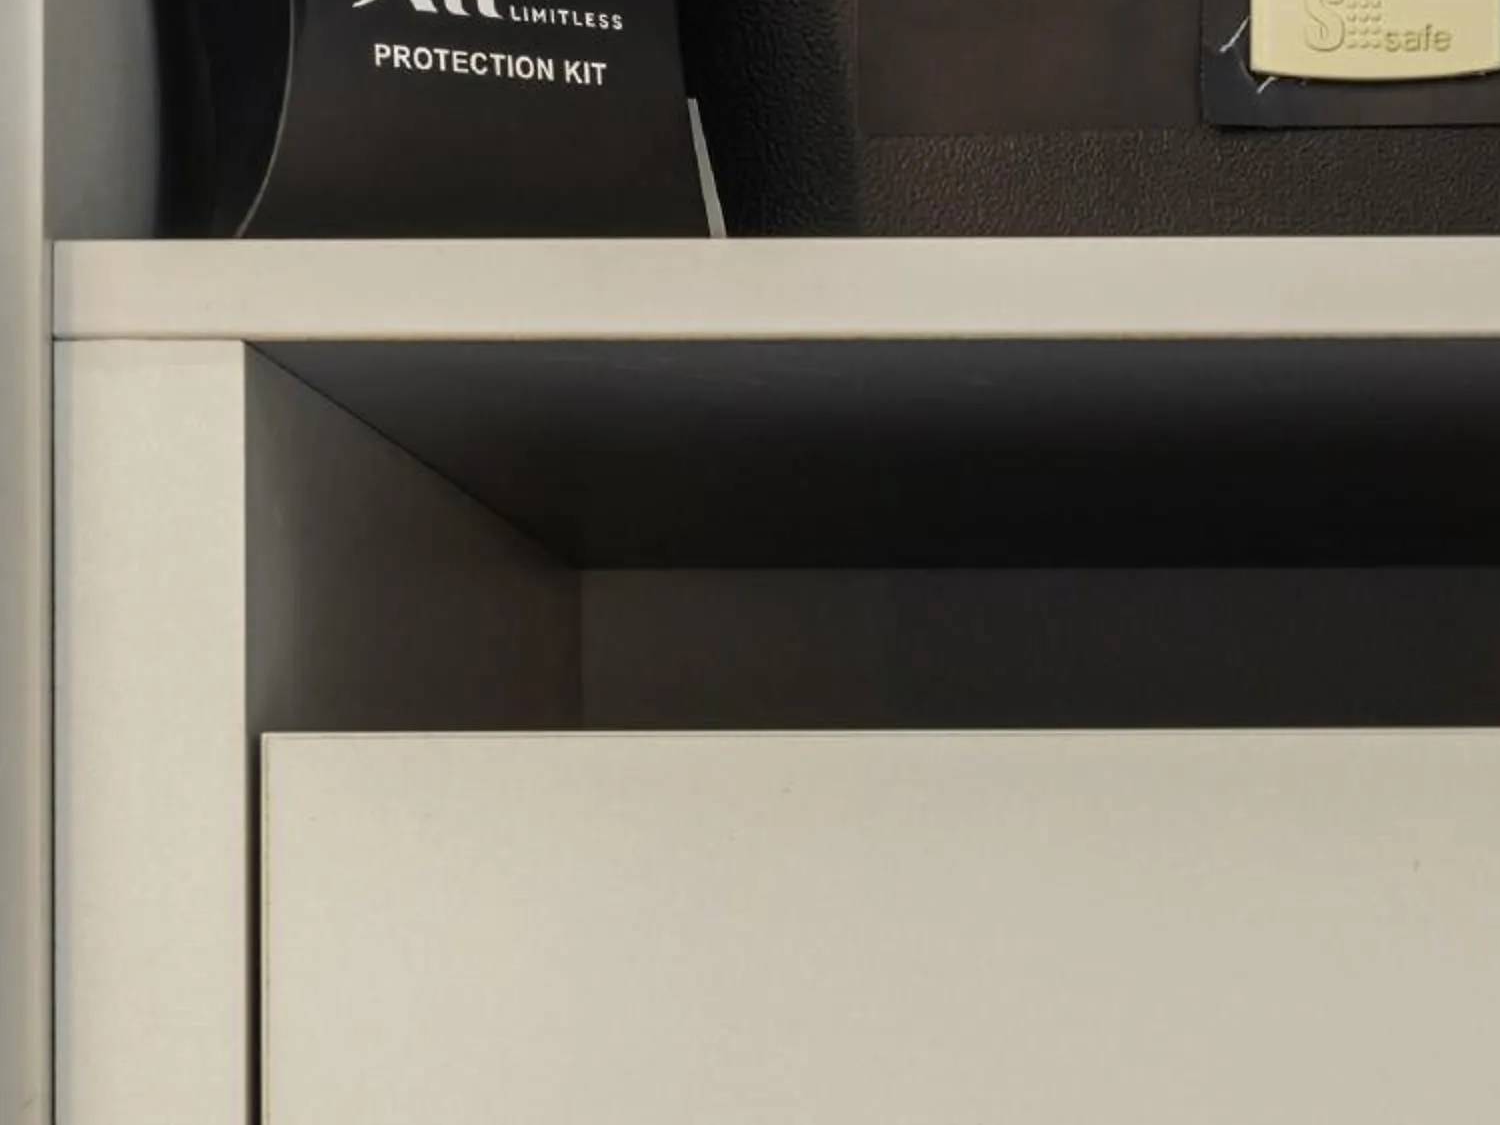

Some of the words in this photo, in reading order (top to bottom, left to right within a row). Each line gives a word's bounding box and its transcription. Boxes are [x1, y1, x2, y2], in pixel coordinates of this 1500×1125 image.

[509, 5, 623, 31] LIMITLESS
[1384, 23, 1452, 53] safe
[374, 43, 555, 81] PROTECTION
[565, 60, 607, 86] KIT
